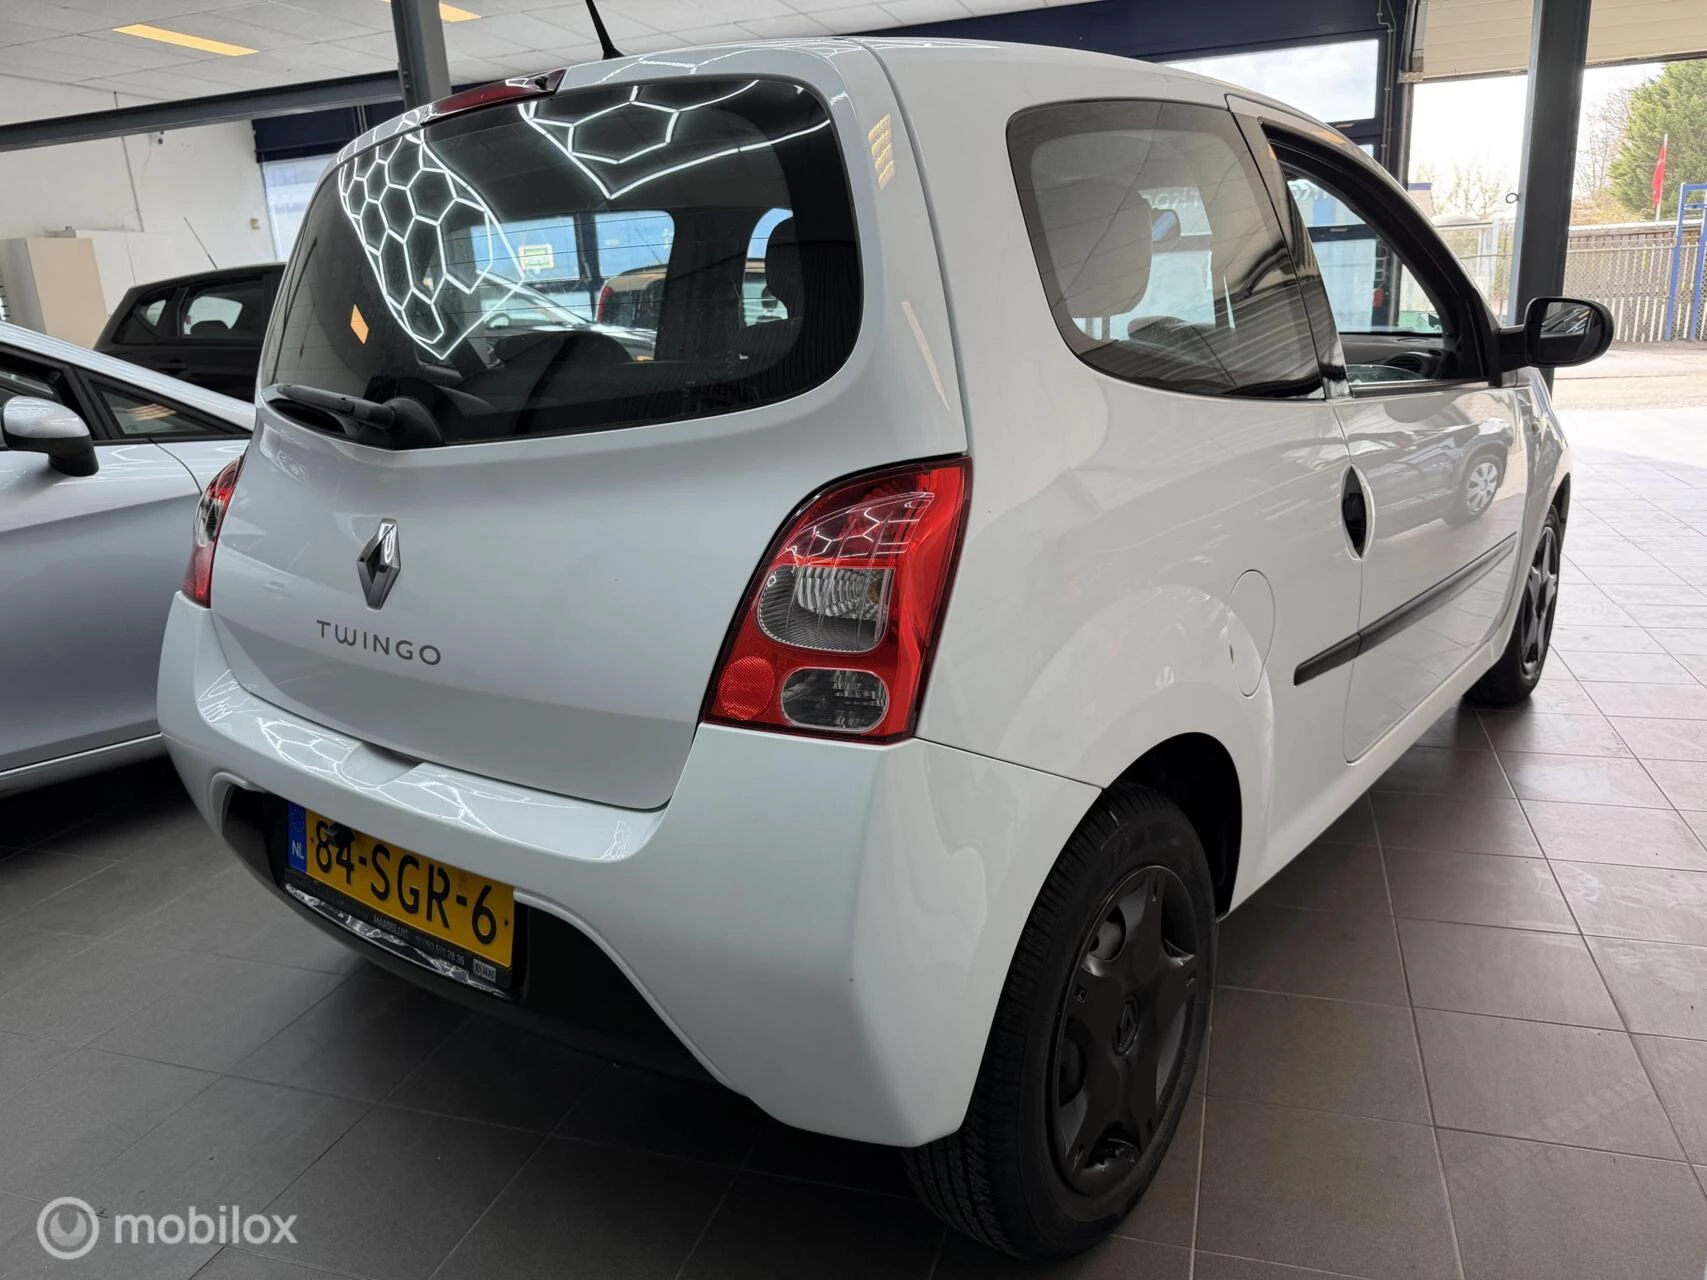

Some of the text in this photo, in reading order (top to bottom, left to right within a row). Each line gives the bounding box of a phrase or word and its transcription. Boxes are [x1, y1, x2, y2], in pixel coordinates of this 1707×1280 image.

[316, 619, 442, 666] TWINGO
[291, 839, 305, 860] NL
[315, 820, 497, 945] 84-SGR-6
